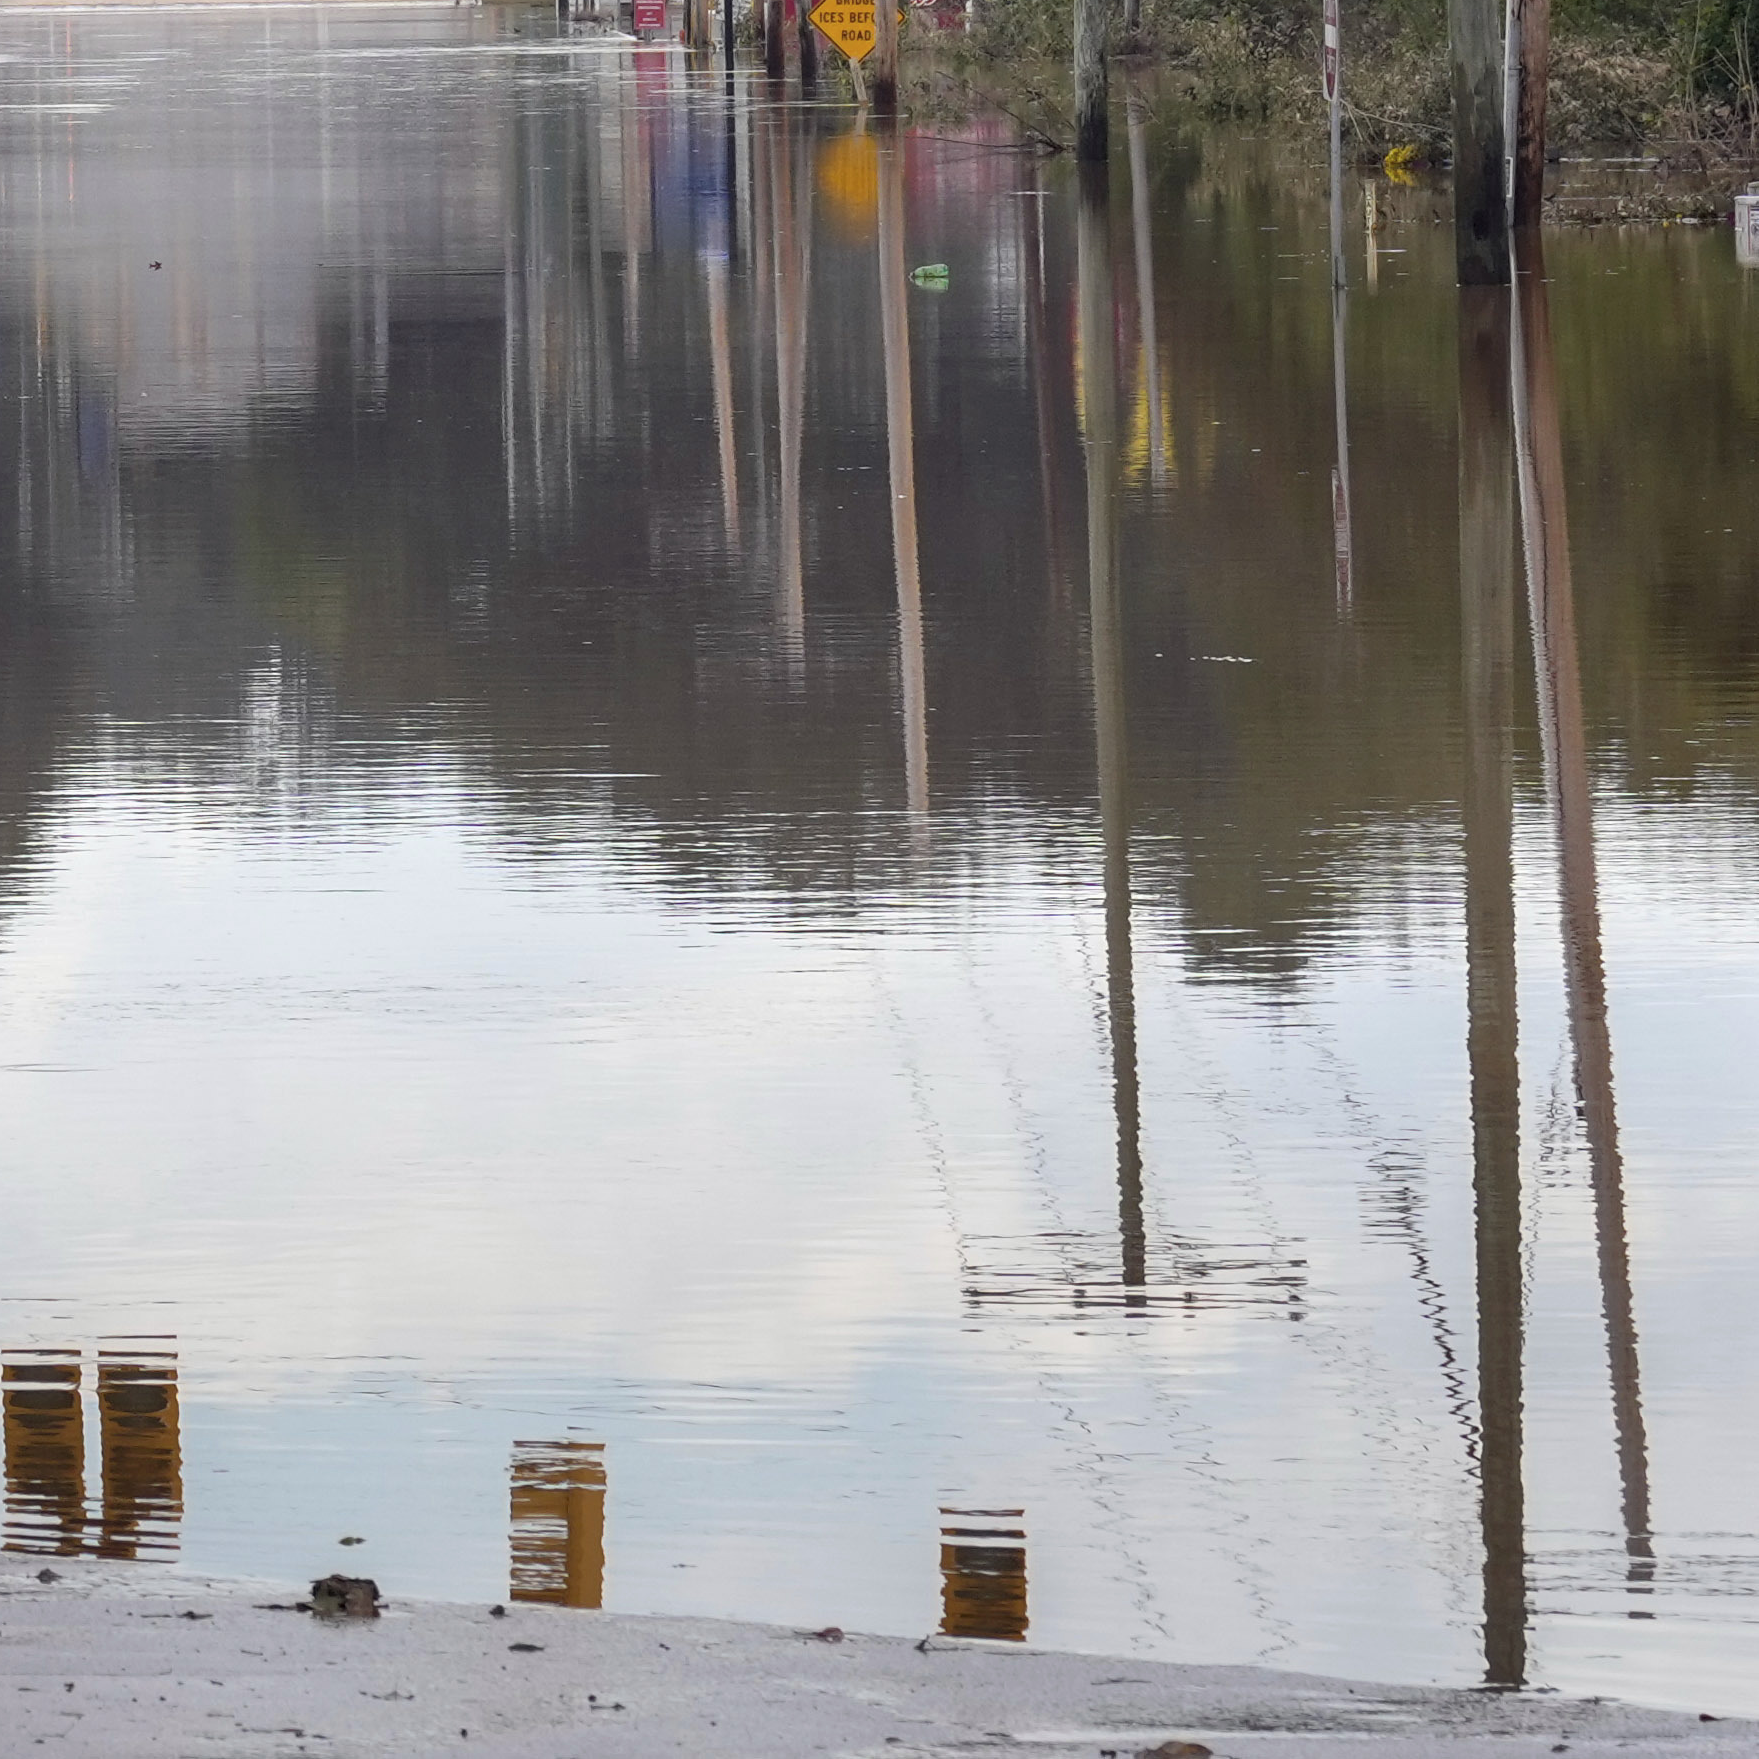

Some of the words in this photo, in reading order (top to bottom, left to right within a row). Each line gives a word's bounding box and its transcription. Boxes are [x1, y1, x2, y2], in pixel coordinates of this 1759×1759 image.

[819, 12, 844, 23] ICES
[849, 12, 875, 23] BEF
[842, 30, 871, 41] ROAD
